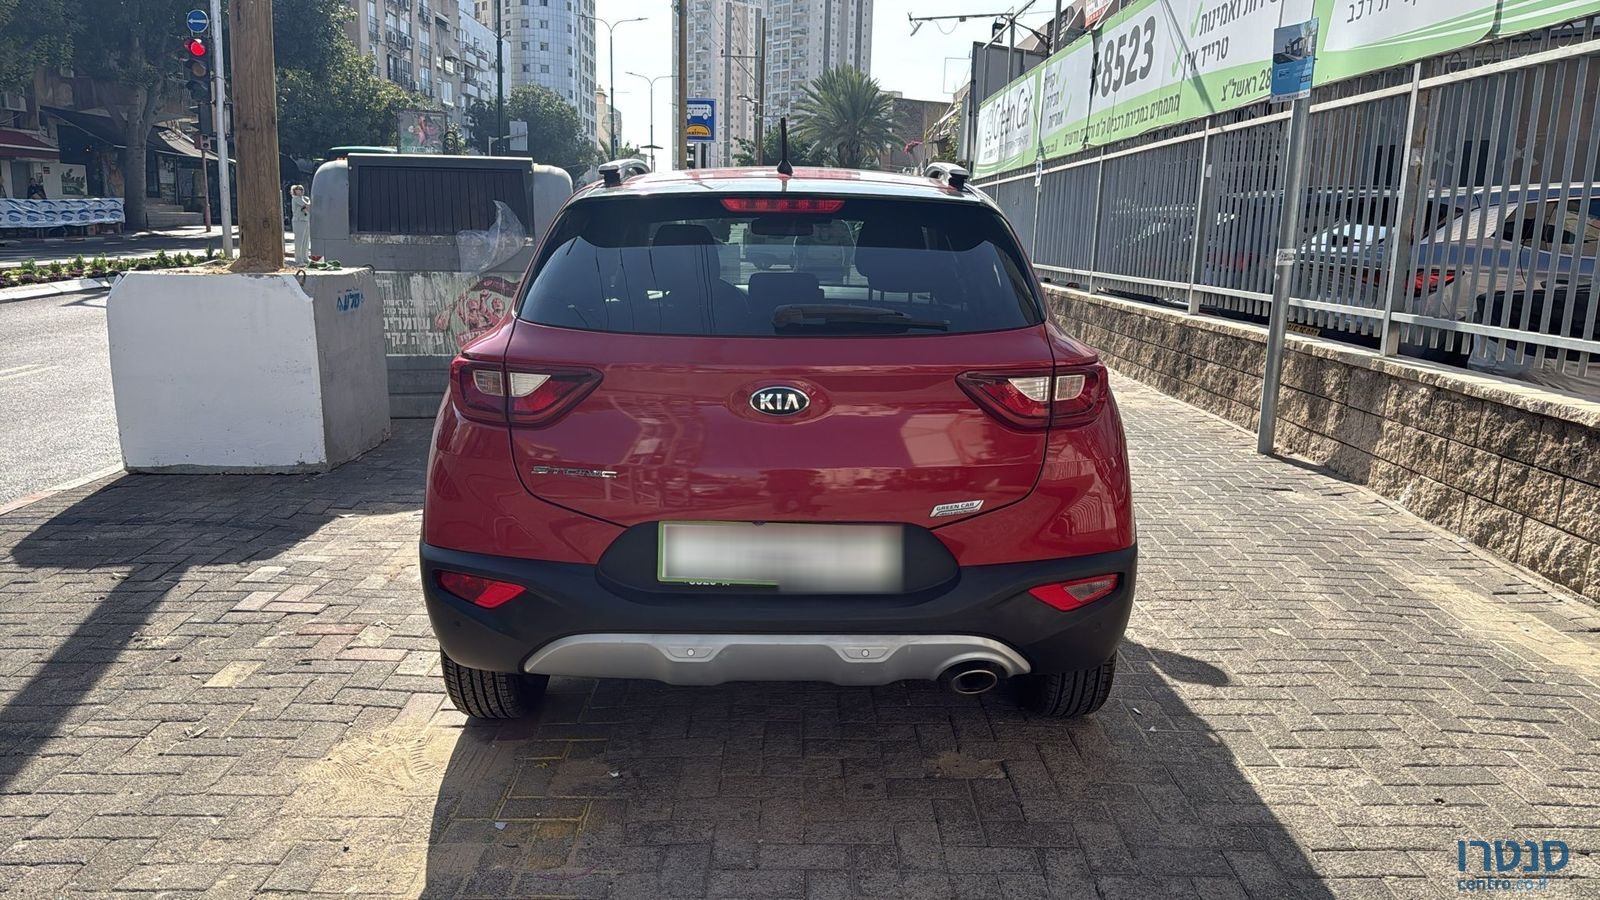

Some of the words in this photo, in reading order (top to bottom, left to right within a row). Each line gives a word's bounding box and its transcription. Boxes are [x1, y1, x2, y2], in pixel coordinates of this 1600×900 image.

[1199, 0, 1240, 36] ואמינות
[1346, 0, 1372, 23] רכב
[1201, 36, 1229, 67] טרייד
[1183, 49, 1199, 80] אין
[1258, 67, 1272, 91] 28
[1124, 105, 1148, 128] במכירת
[1150, 94, 1180, 119] מתמחים
[760, 394, 799, 409] KIA
